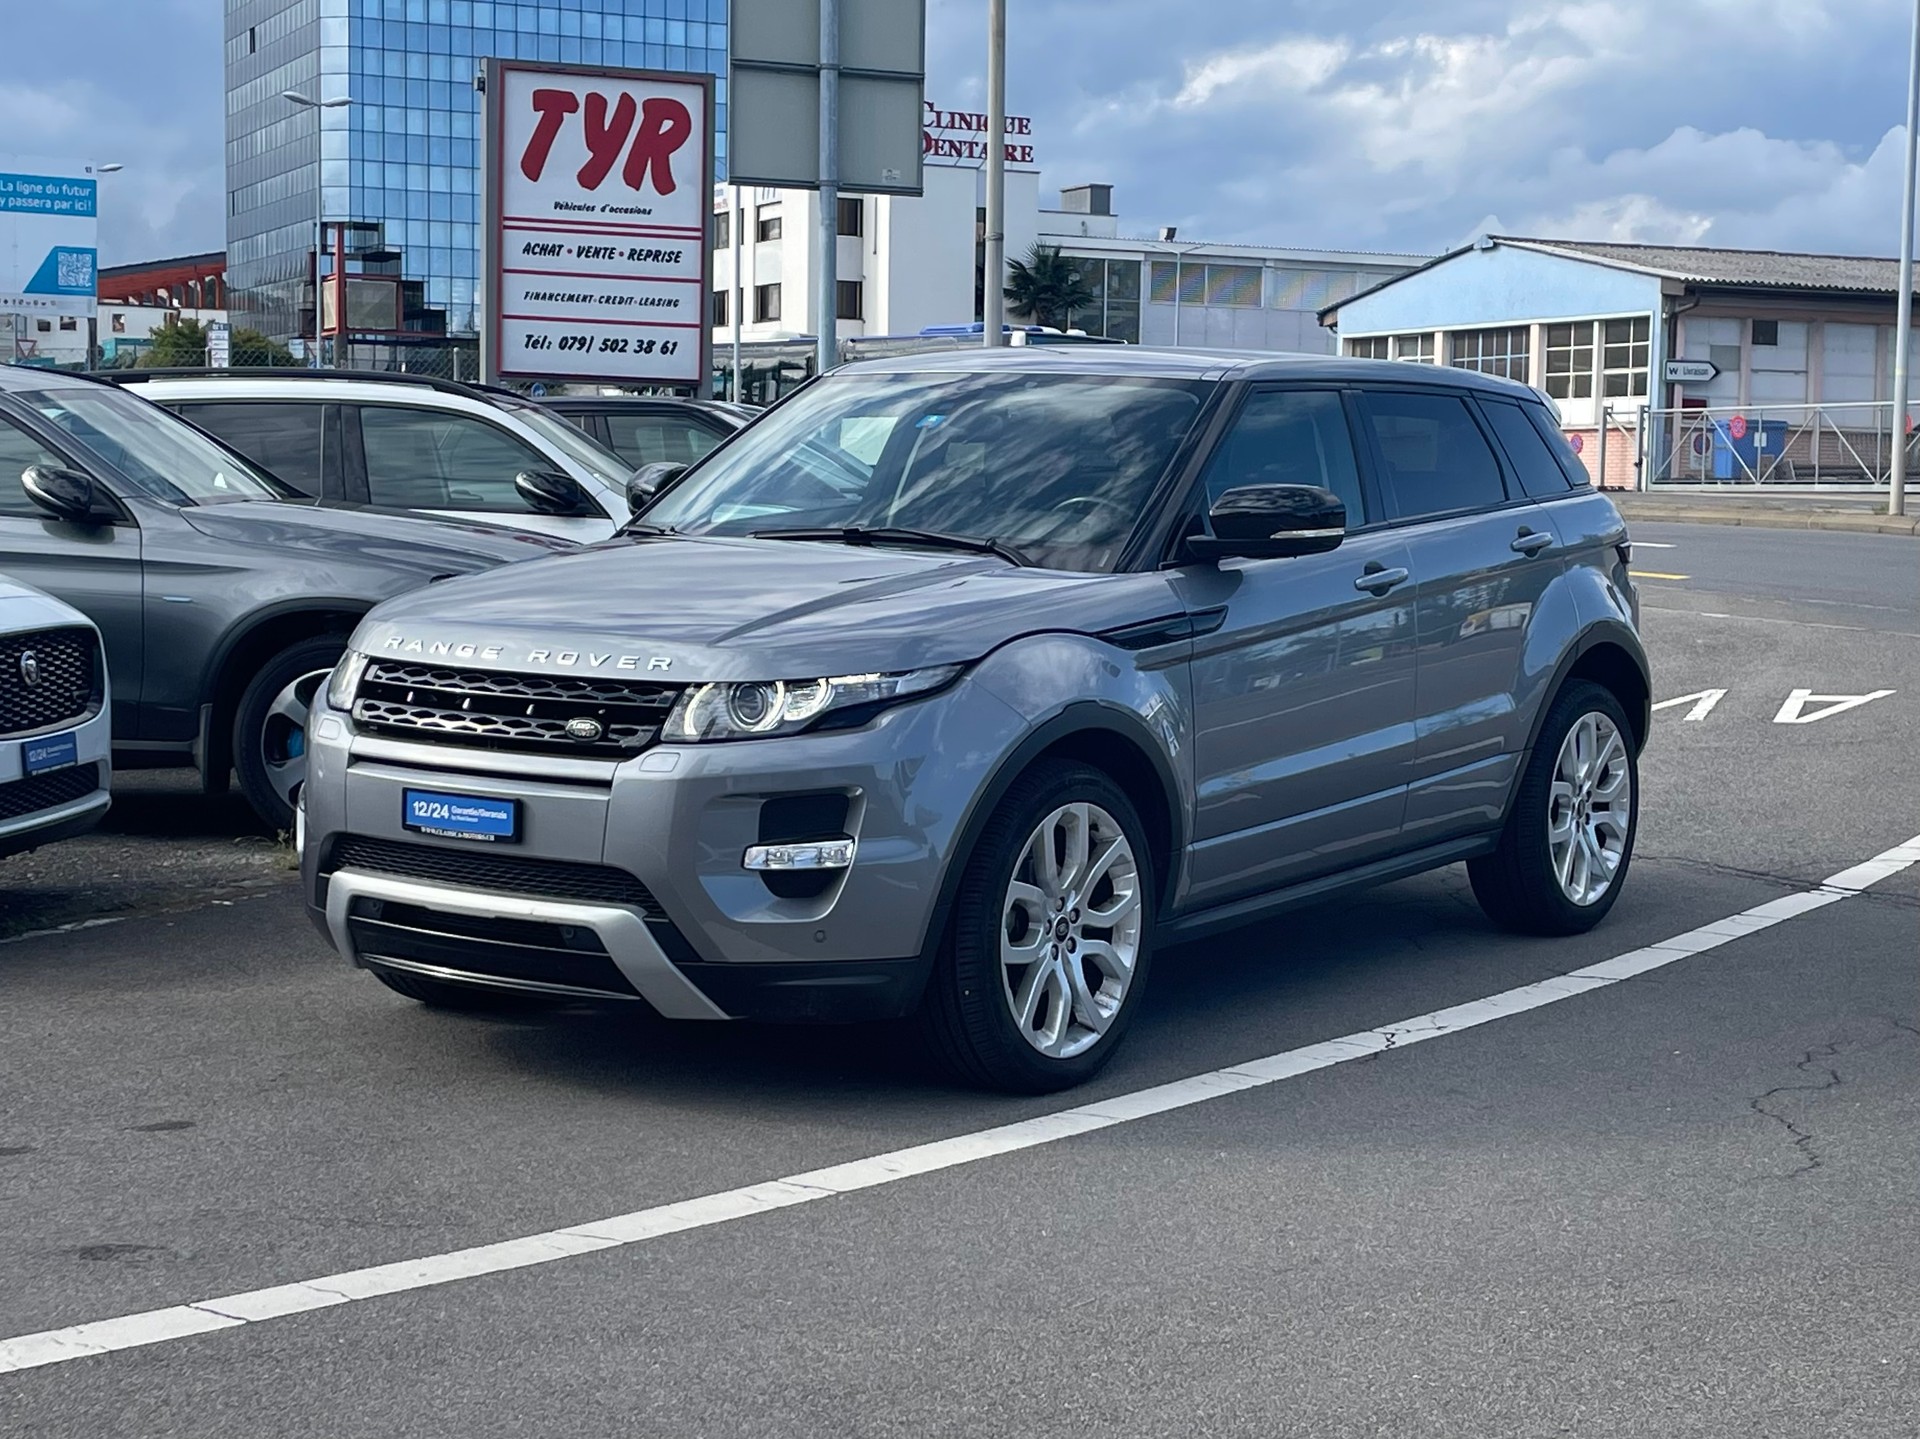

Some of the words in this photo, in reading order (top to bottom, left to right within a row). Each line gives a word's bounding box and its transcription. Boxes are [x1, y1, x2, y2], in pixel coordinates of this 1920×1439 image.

[520, 89, 692, 196] TYR
[0, 180, 13, 192] La
[16, 181, 43, 195] ligne
[45, 184, 60, 195] du
[62, 184, 92, 197] futur
[8, 197, 52, 209] passera
[53, 200, 72, 211] par
[522, 242, 564, 257] ACHAT
[576, 245, 617, 260] VENTE
[627, 248, 683, 264] REPRISE
[523, 291, 594, 304] FINANCEMENT
[638, 297, 680, 308] LEASING
[598, 338, 629, 353] 502
[633, 340, 656, 354] 38
[660, 341, 678, 355] 61
[383, 636, 503, 659] RANGE
[527, 649, 673, 671] ROVER
[412, 800, 450, 820] 12/24
